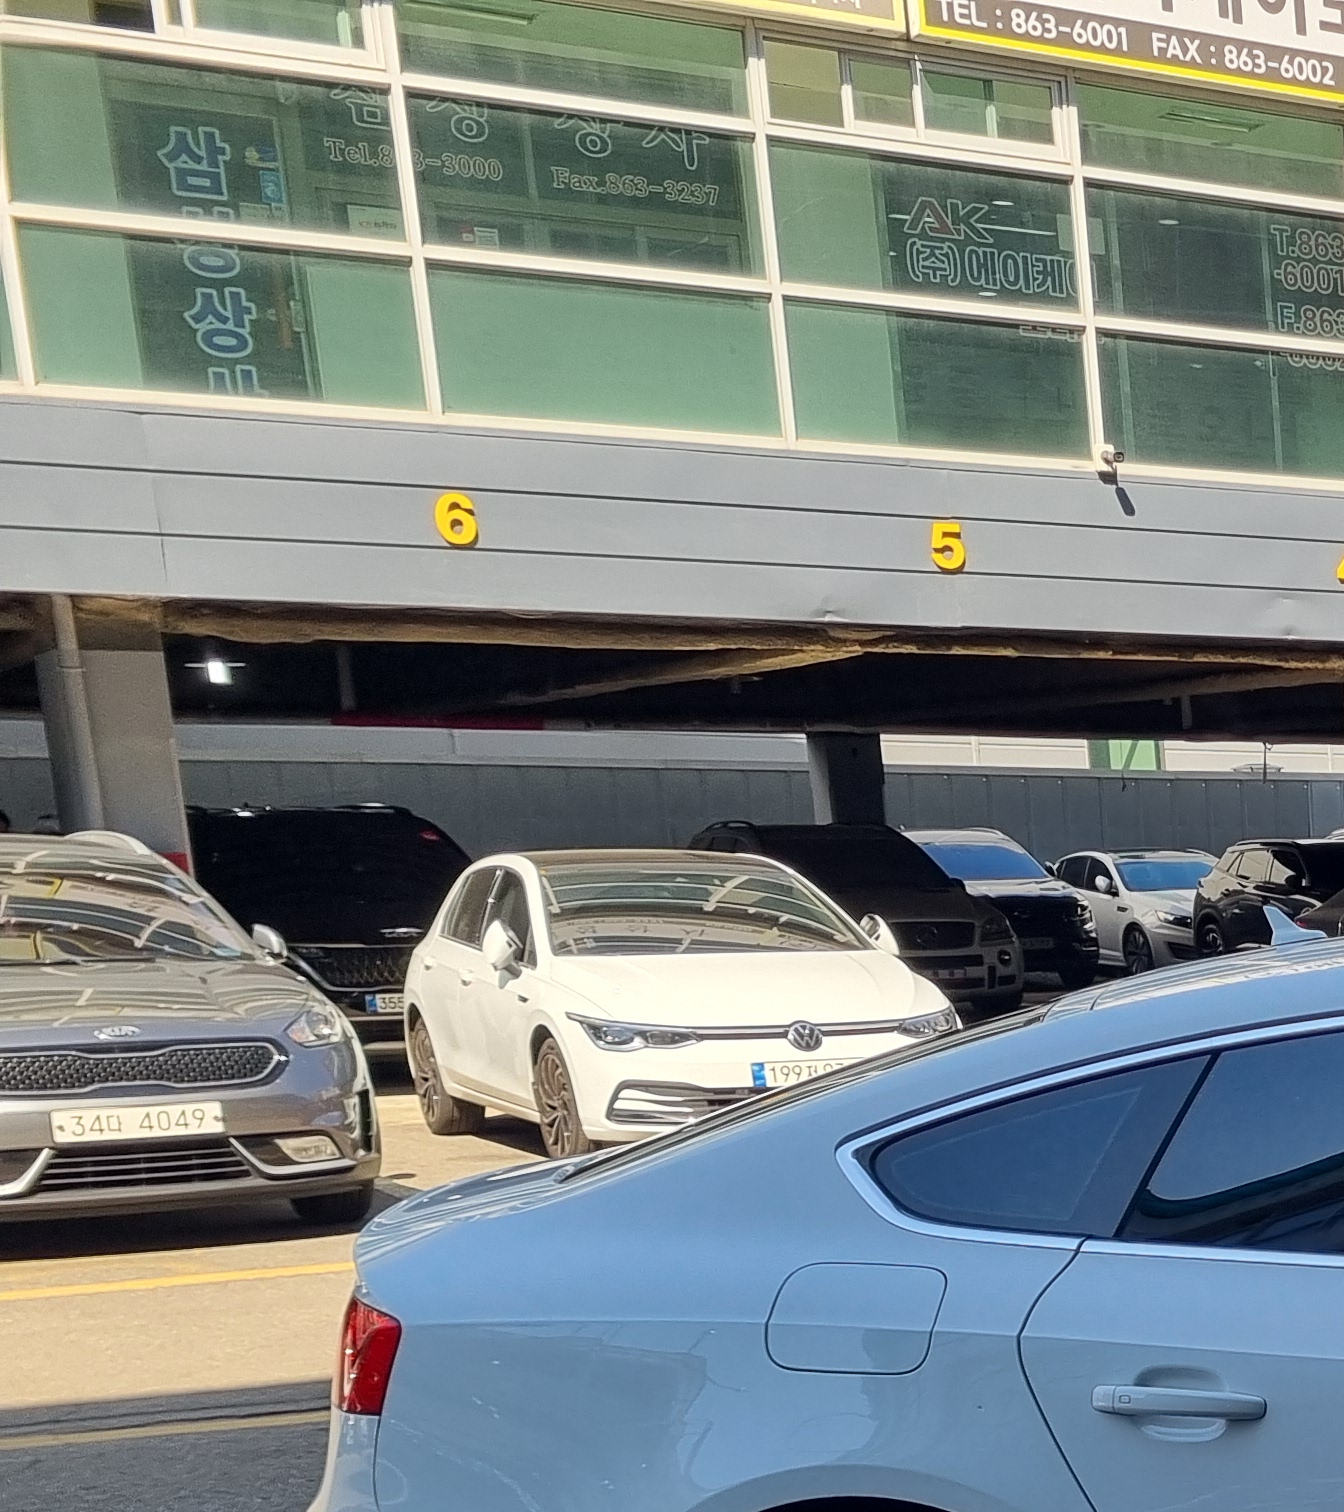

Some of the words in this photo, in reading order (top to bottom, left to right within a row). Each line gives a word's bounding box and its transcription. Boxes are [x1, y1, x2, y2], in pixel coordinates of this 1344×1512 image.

[939, 0, 988, 28] TEL
[1010, 7, 1128, 51] 863-6001
[1151, 32, 1202, 65] FAX
[1224, 44, 1336, 86] 863-6002
[324, 137, 503, 181] Tel.83-3000
[904, 197, 994, 243] AK
[436, 493, 478, 546] 6
[932, 522, 966, 572] 5
[70, 1115, 122, 1136] 34다
[139, 1109, 206, 1132] 4049
